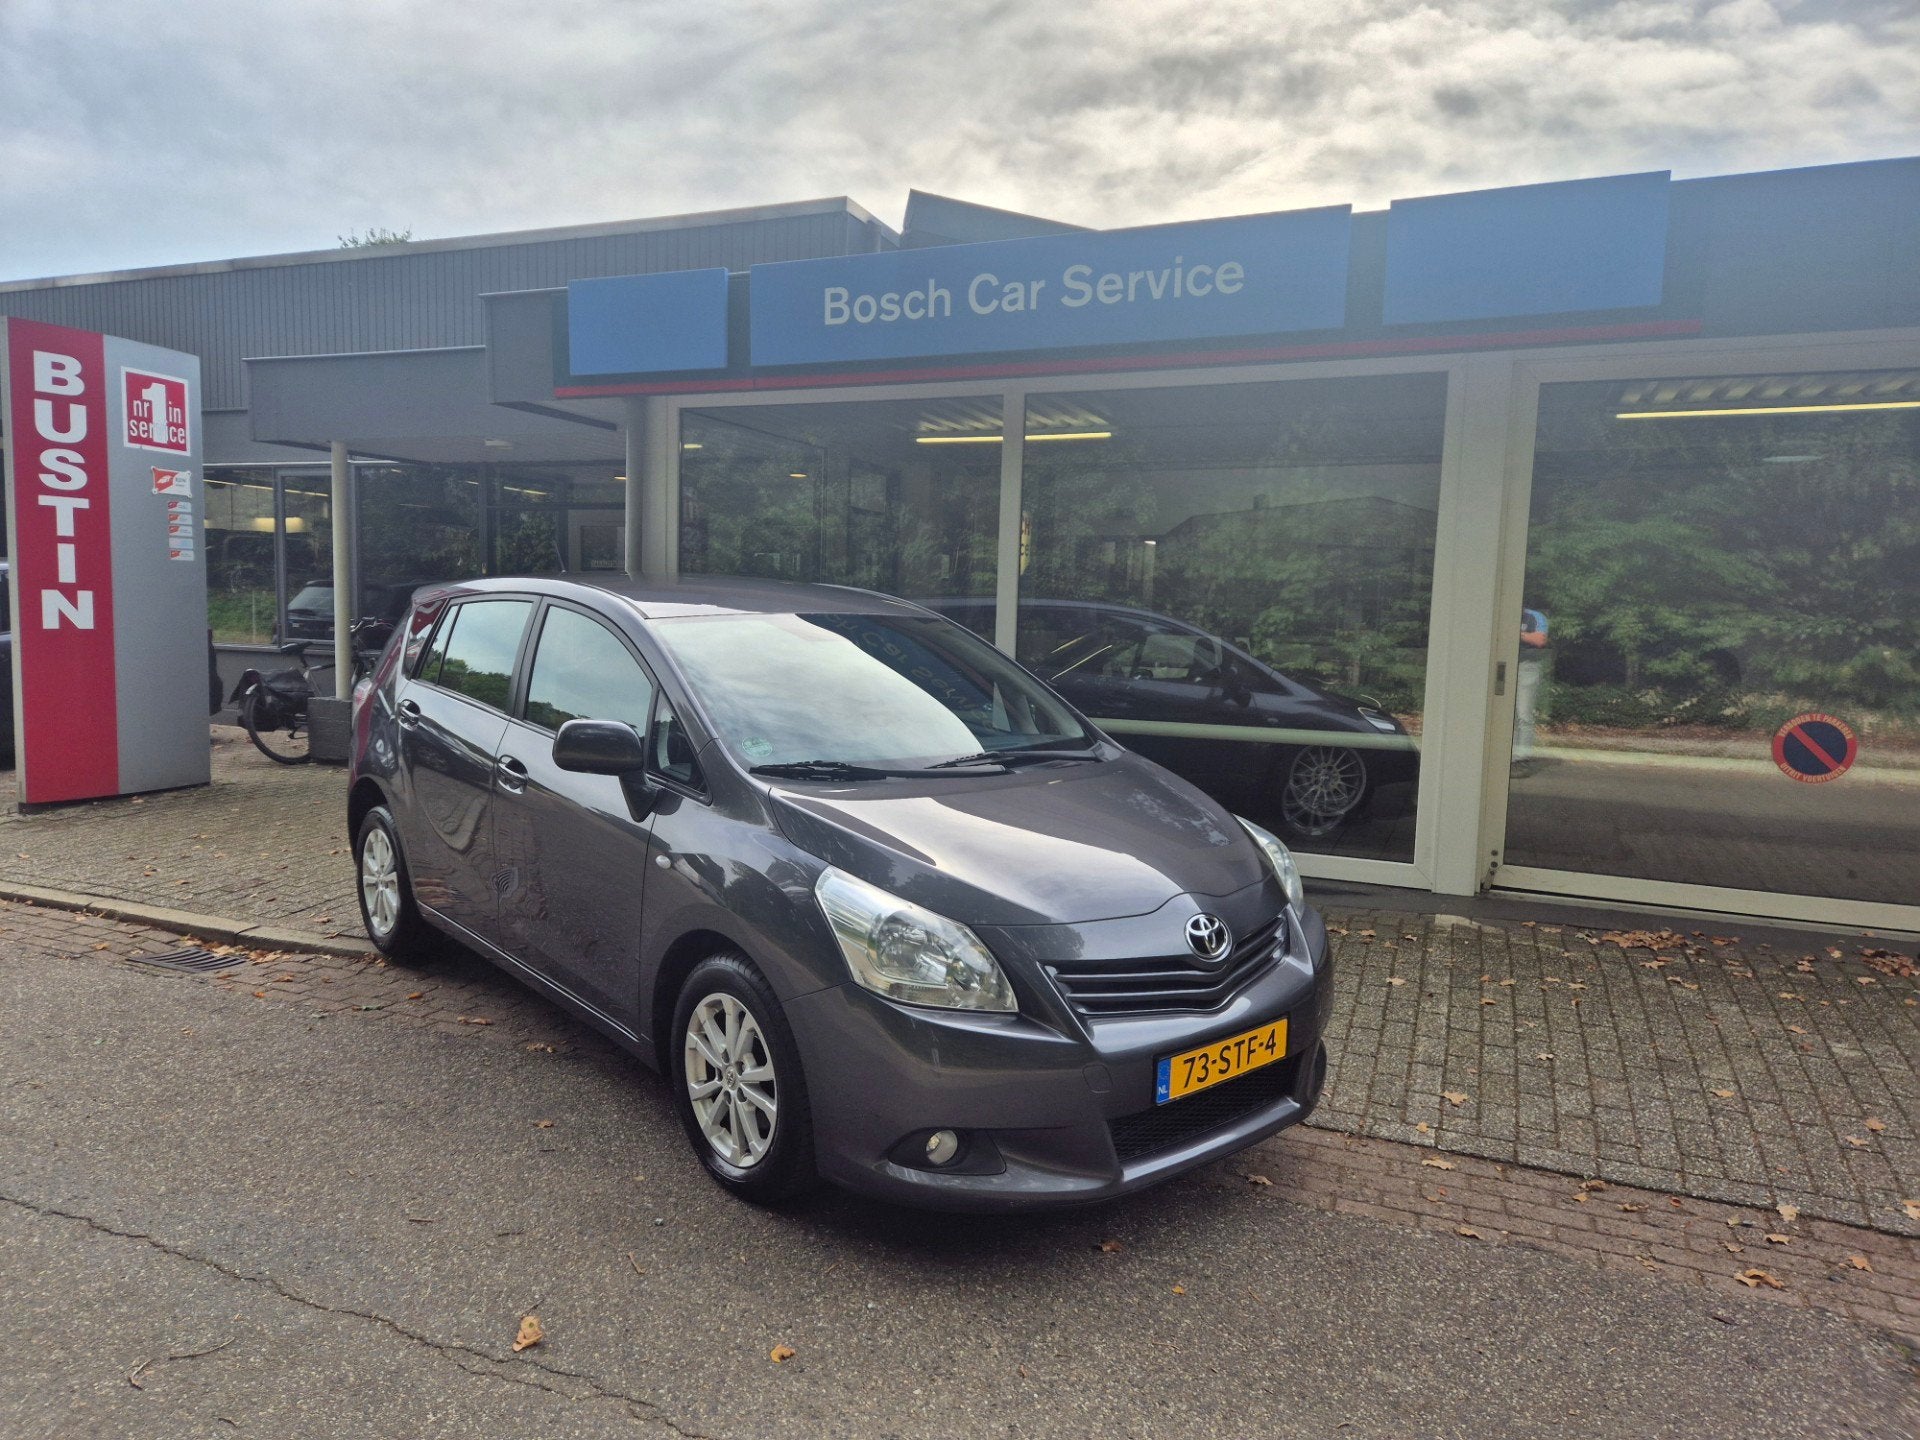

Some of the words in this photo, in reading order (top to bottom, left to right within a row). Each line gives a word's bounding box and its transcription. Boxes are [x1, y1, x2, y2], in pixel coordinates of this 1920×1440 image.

[823, 278, 952, 326] Bosch
[967, 272, 1046, 316] Car
[1060, 255, 1245, 308] Service
[133, 400, 150, 418] nr
[141, 382, 168, 444] 1
[168, 400, 182, 424] in
[33, 350, 95, 630] BUSTIN
[1813, 714, 1822, 722] TE
[1183, 1028, 1277, 1089] 73-STF-4
[1158, 1086, 1168, 1095] NL
